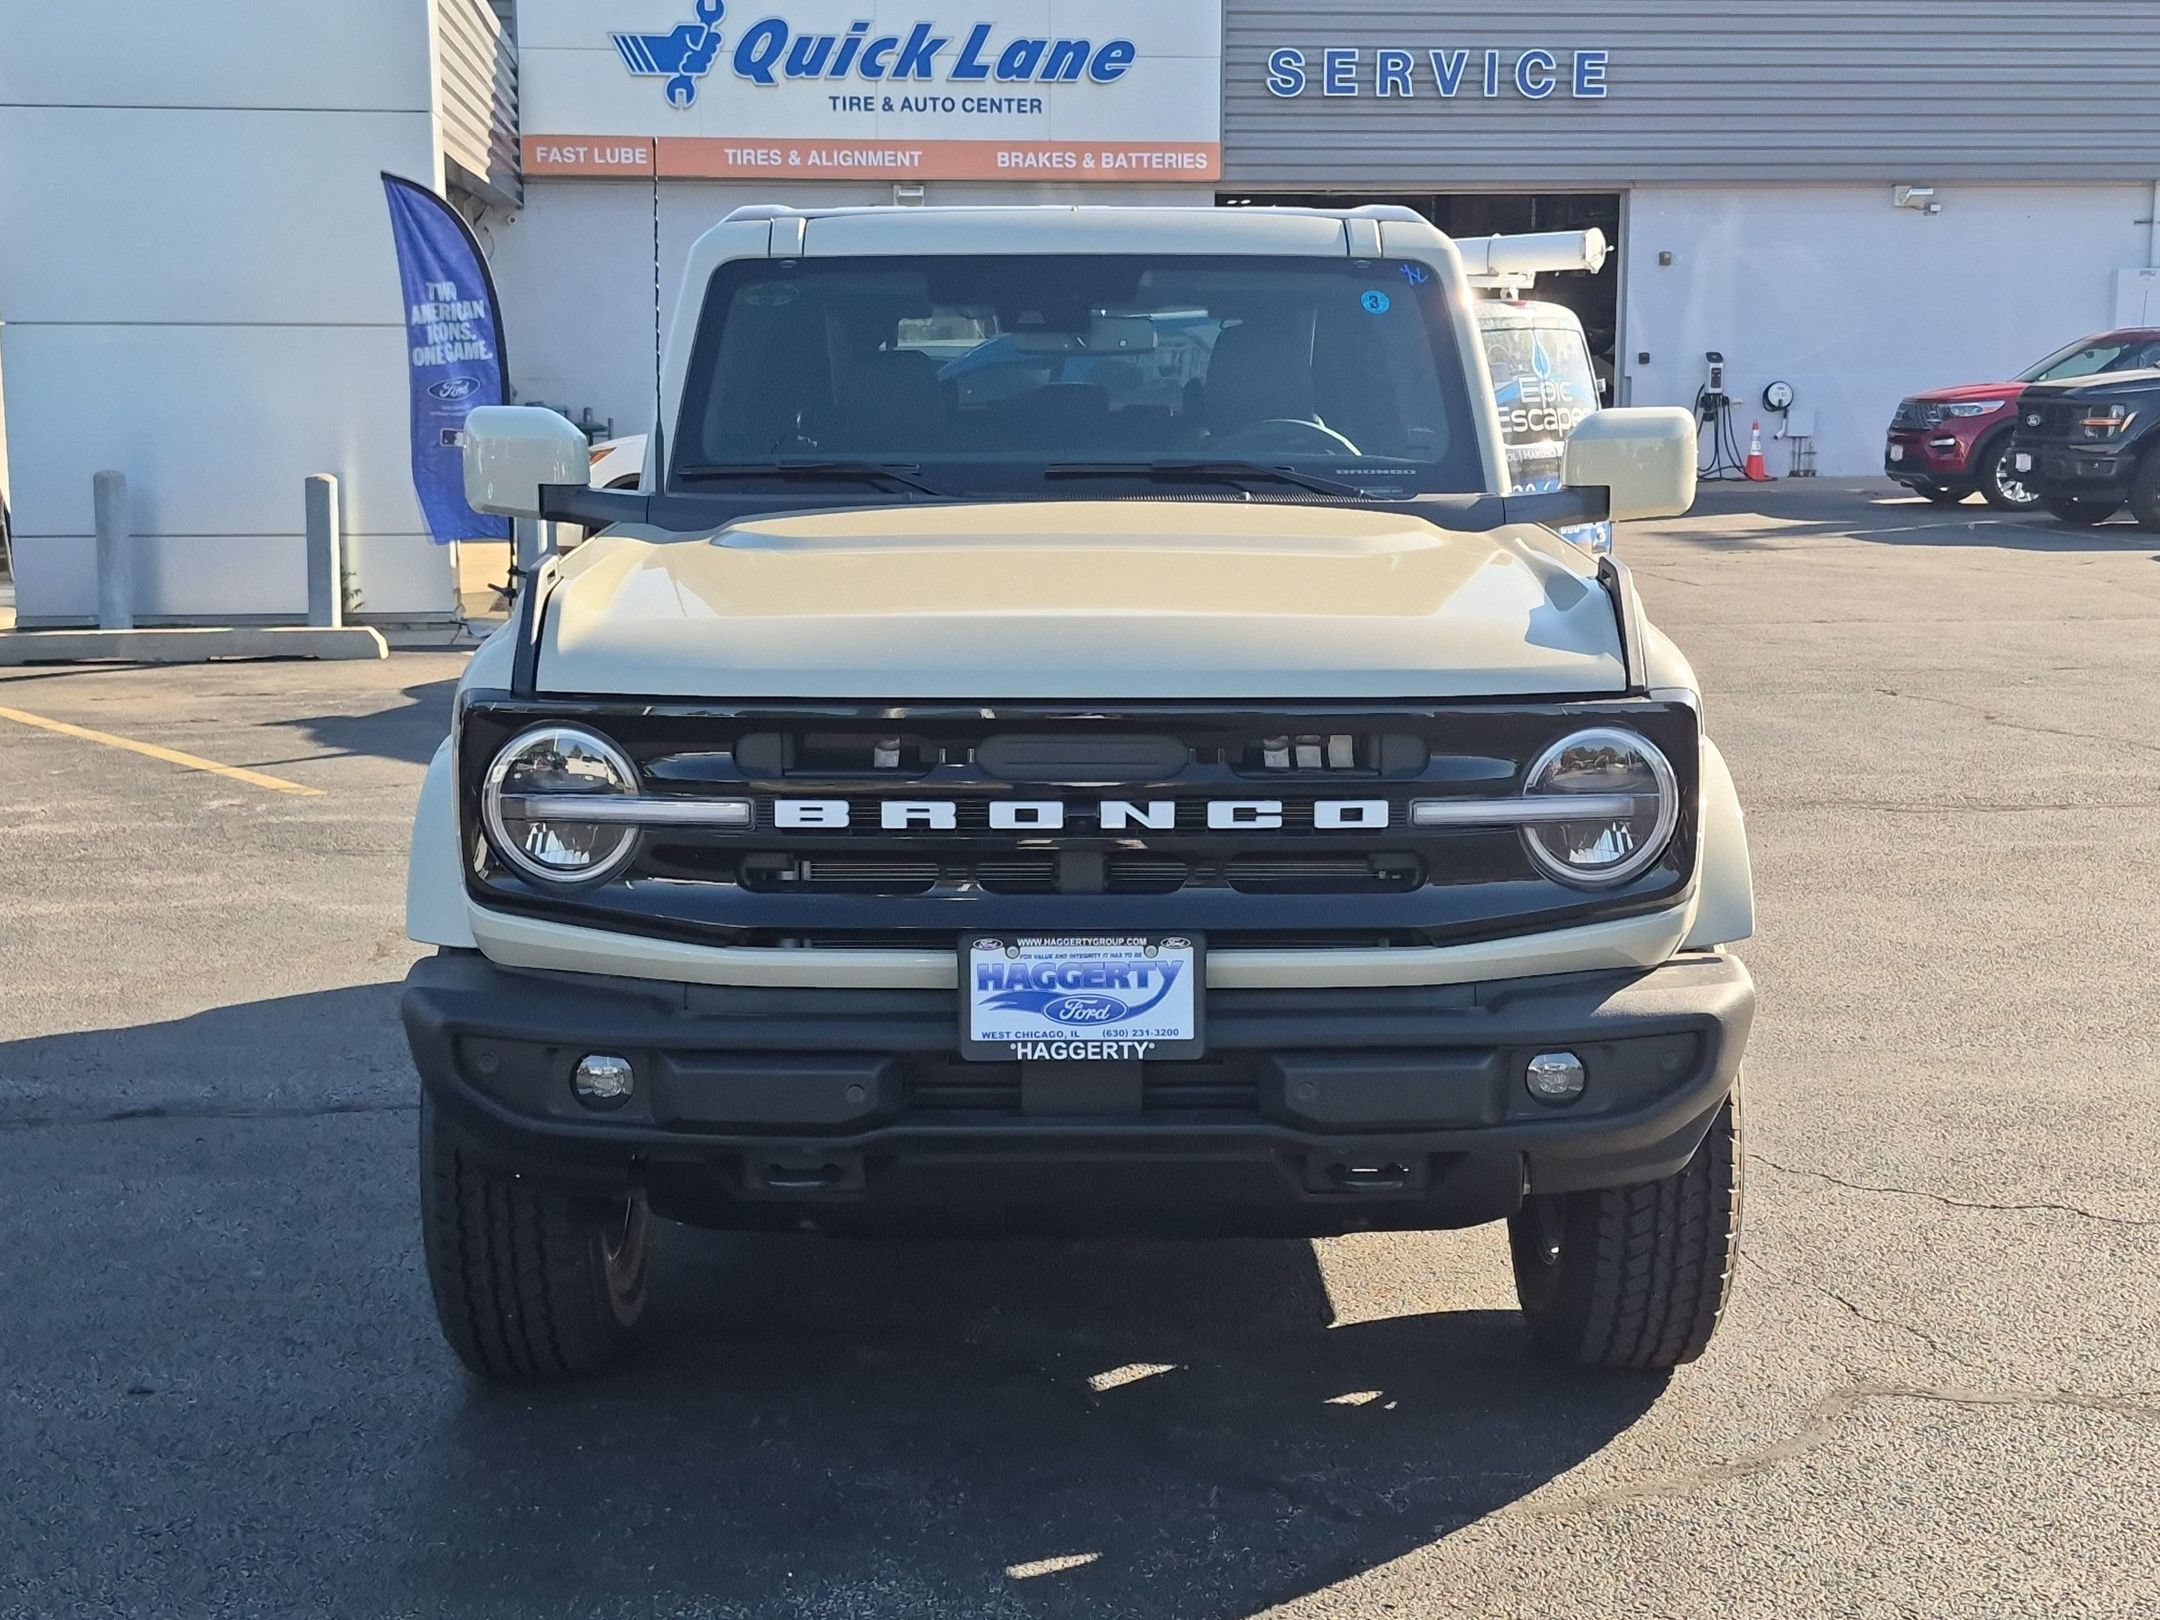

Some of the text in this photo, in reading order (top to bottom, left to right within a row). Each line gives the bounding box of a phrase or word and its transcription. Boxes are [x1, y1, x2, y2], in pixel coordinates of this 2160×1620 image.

[732, 17, 1137, 86] Quick Lane
[1266, 47, 1609, 99] SERVICE
[829, 96, 1043, 114] TIRE & AUTO CENTER
[535, 146, 648, 164] FAST LUBE
[724, 149, 923, 168] TIRES & ALIGNMENT
[996, 151, 1208, 169] BRAKES & BATTERIES
[1518, 376, 1573, 408] Epic
[774, 800, 1390, 830] BRONCO
[1017, 937, 1147, 947] WWW.HAGGERTYGROUP.COM
[976, 960, 1184, 992] HAGGERTY
[981, 1028, 1180, 1041] WEST CHICAGO, IL (630) 231-3200
